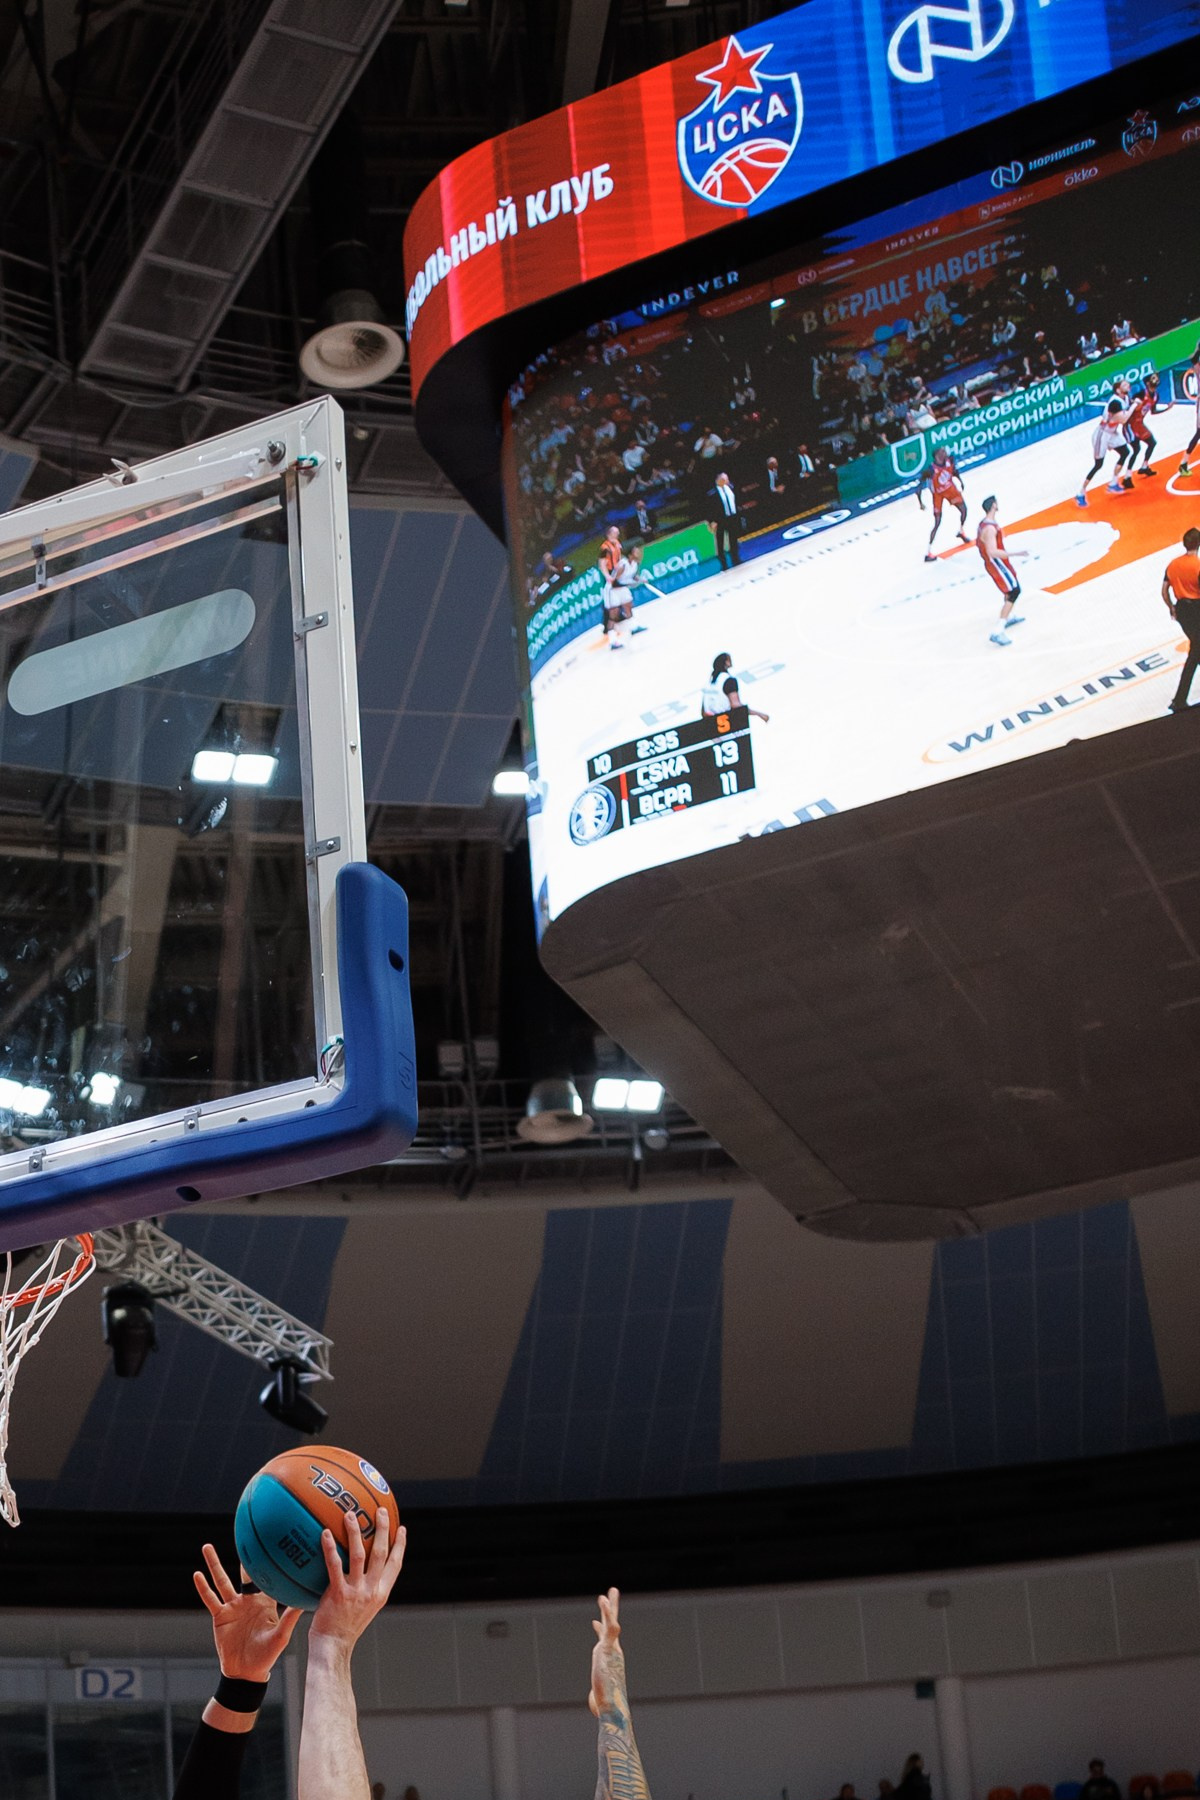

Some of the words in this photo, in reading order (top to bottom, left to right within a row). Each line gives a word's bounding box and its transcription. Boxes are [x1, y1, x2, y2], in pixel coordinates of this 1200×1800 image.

[693, 93, 790, 155] ЦСКА
[1028, 138, 1096, 171] НОРНИКЕЛЬ
[525, 163, 615, 228] КЛУБ
[640, 270, 740, 316] INDEVER
[822, 275, 913, 328] СЕРДЦЕ
[929, 376, 1066, 445] МОСКОВСКИЙ
[945, 389, 1084, 457] НДОКРИННЫЙ
[639, 548, 699, 582] АВОД
[948, 652, 1169, 753] WINLINE
[716, 714, 732, 733] 5
[636, 755, 690, 787] CSKA
[719, 770, 738, 795] 11
[278, 1534, 313, 1570] FIBA
[80, 1667, 136, 1699] D2
